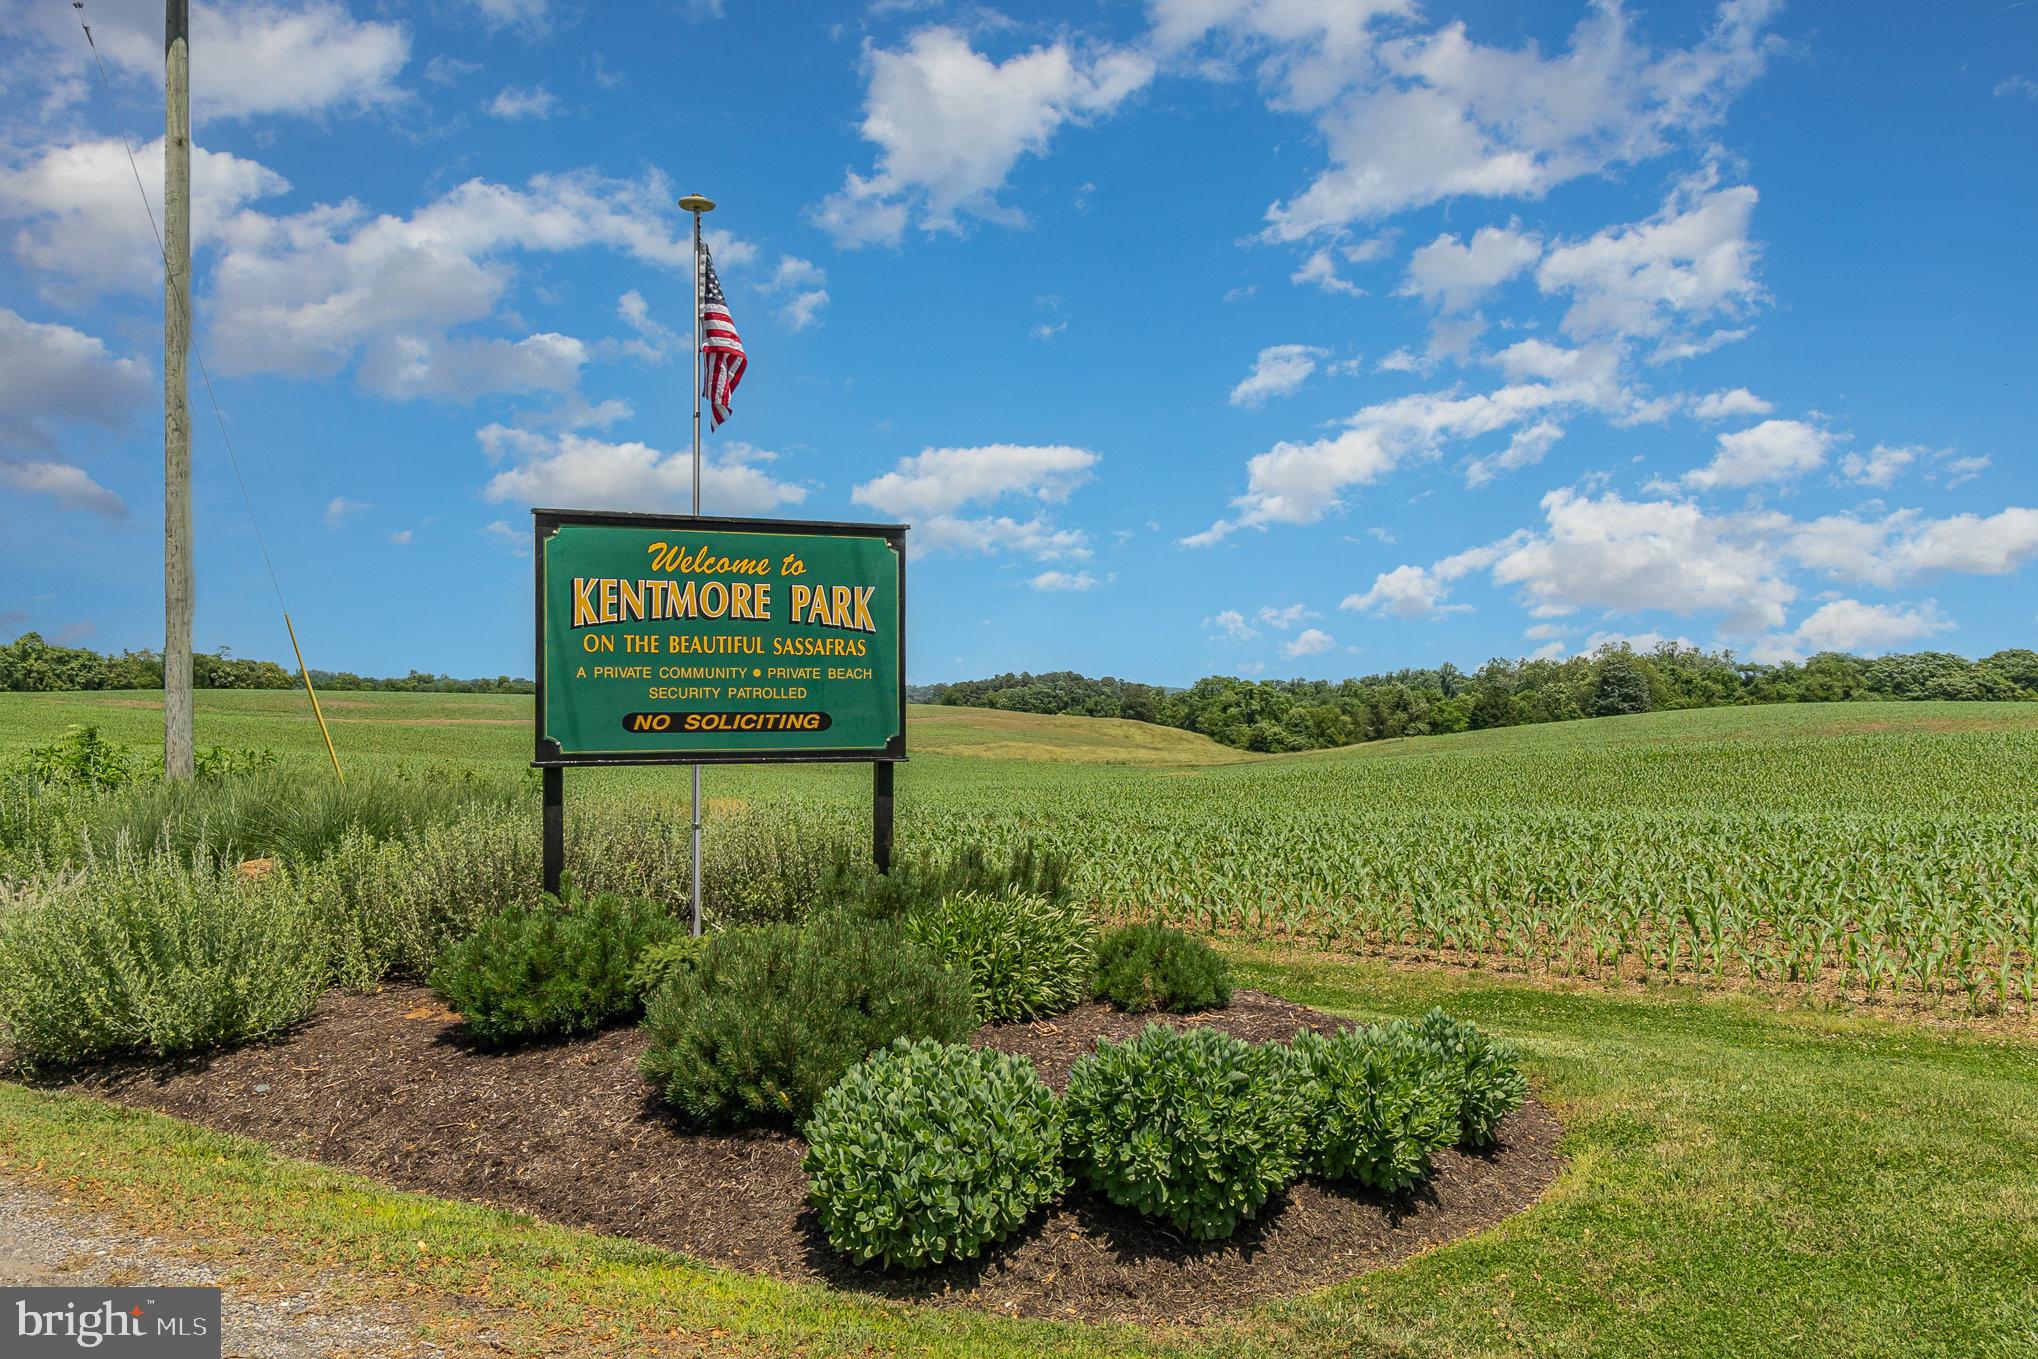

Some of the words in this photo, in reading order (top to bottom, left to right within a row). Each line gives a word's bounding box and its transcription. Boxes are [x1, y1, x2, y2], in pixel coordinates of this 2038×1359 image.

[647, 541, 771, 576] Welcome
[780, 552, 807, 577] to
[571, 577, 771, 629] KENTMORE
[789, 584, 877, 633] PARK
[583, 634, 615, 653] ON
[624, 634, 659, 653] THE
[669, 635, 765, 655] BEAUTIFUL
[773, 637, 867, 657] SASSAFRAS
[576, 666, 587, 679] A
[594, 666, 652, 679] PRIVATE
[659, 666, 748, 679] COMMUNITY
[768, 667, 821, 680] PRIVATE
[828, 668, 872, 680] BEACH
[649, 687, 721, 700] SECURITY
[728, 687, 807, 700] PATROLLED
[634, 714, 671, 731] NO
[685, 713, 821, 731] SOLICITING
